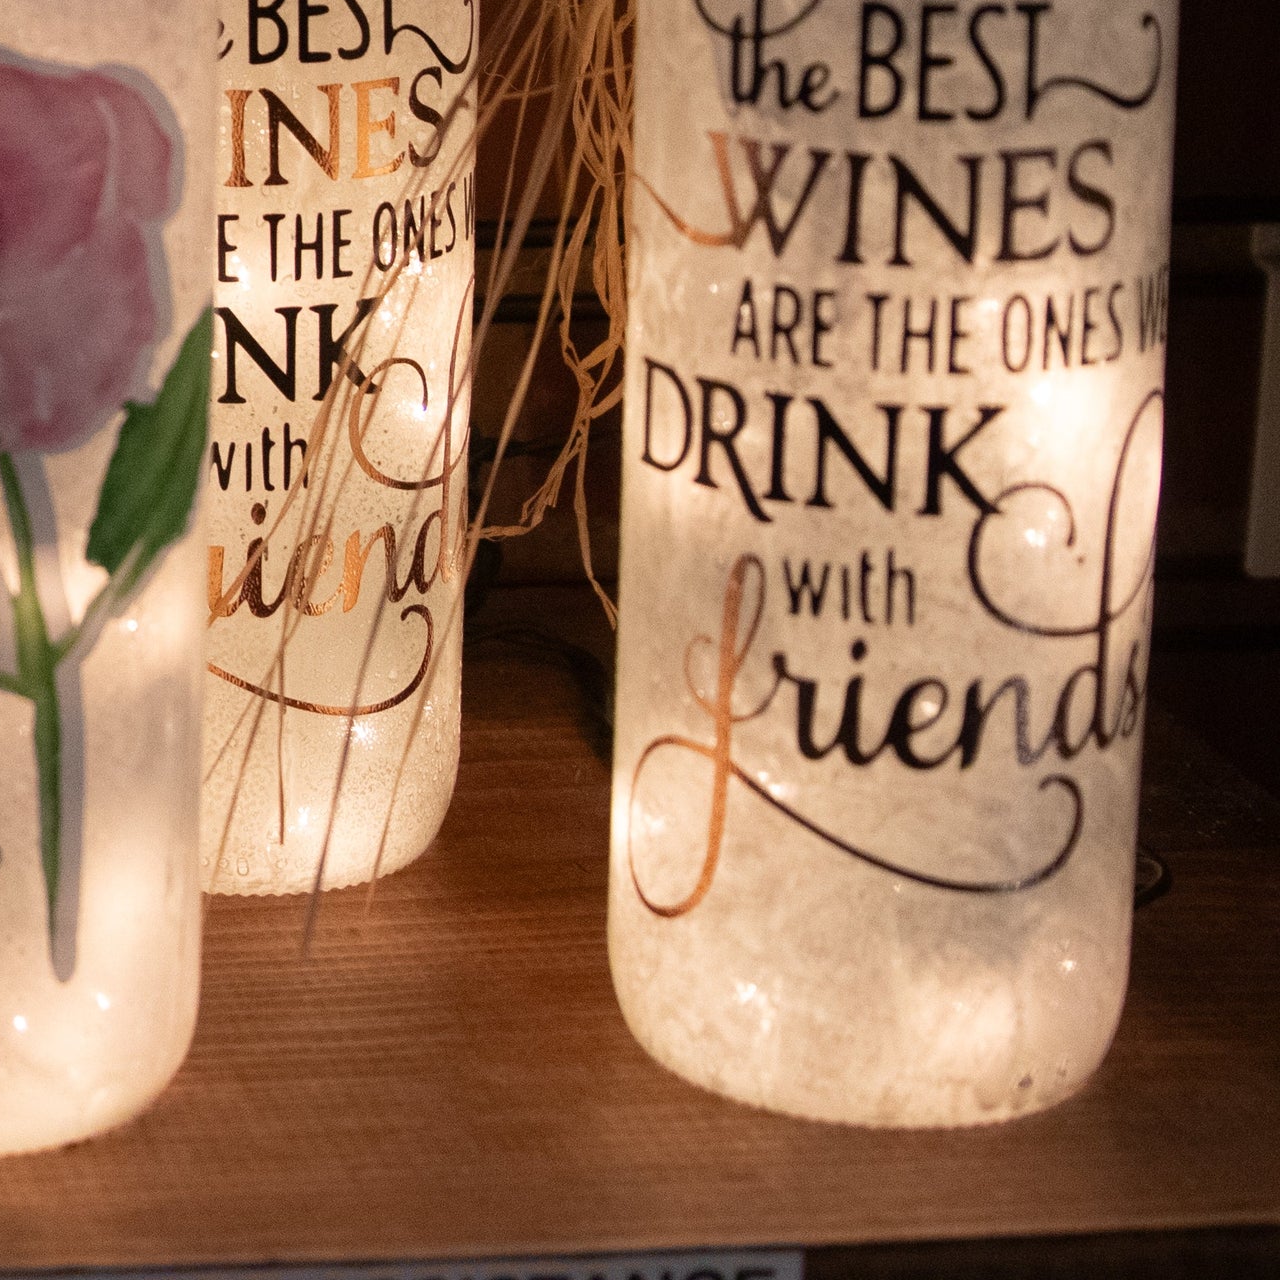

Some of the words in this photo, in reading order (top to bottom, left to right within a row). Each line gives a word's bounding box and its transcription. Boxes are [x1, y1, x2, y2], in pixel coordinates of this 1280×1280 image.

[223, 66, 444, 188] INES
[263, 210, 353, 282] THE
[372, 181, 458, 272] ONES
[631, 131, 1118, 268] WINES
[213, 296, 383, 404] NK
[730, 277, 837, 368] ARE
[866, 294, 974, 376] THE
[1001, 281, 1125, 376] ONES
[640, 356, 1006, 523] DRINK
[782, 547, 919, 627] with
